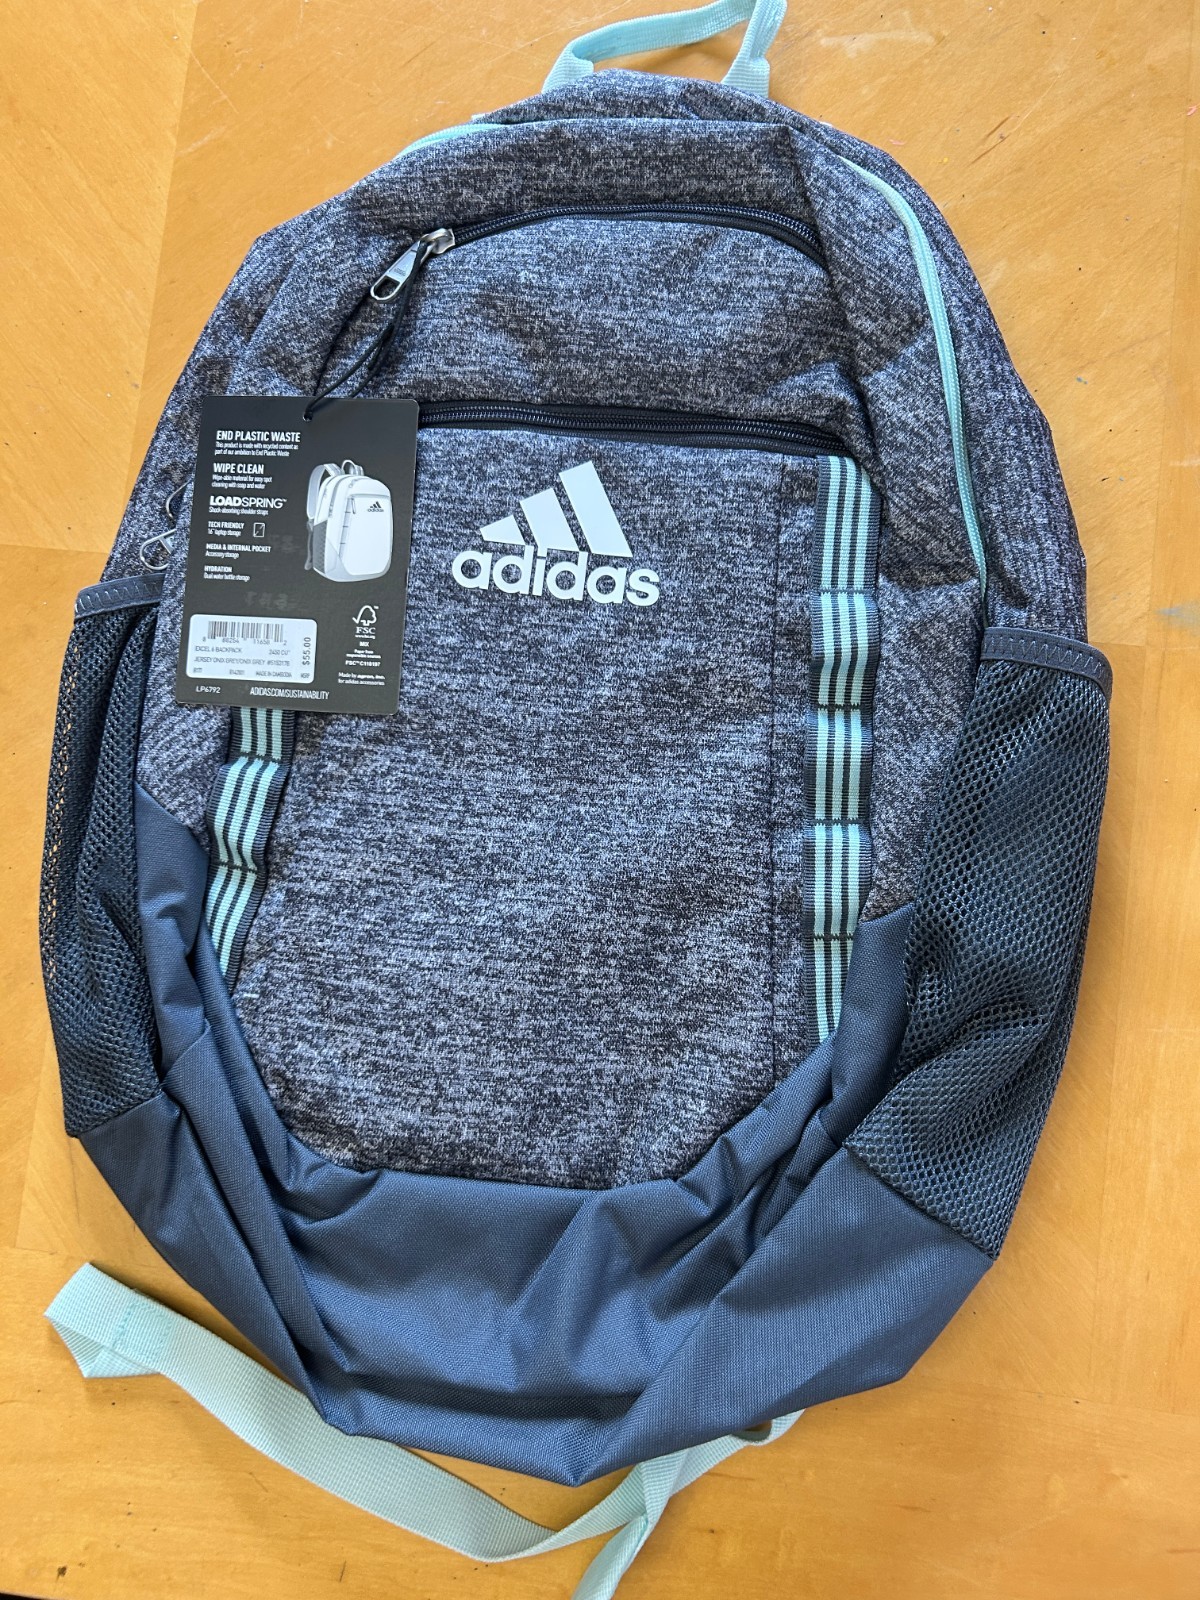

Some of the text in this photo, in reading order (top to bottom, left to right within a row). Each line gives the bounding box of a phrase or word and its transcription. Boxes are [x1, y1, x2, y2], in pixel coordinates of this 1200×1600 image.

[216, 430, 301, 442] END PLASTIC WASTE
[213, 463, 264, 474] WIPE CLEAN
[452, 545, 660, 606] adidas
[302, 636, 311, 666] $55.00
[196, 685, 220, 693] LP6792
